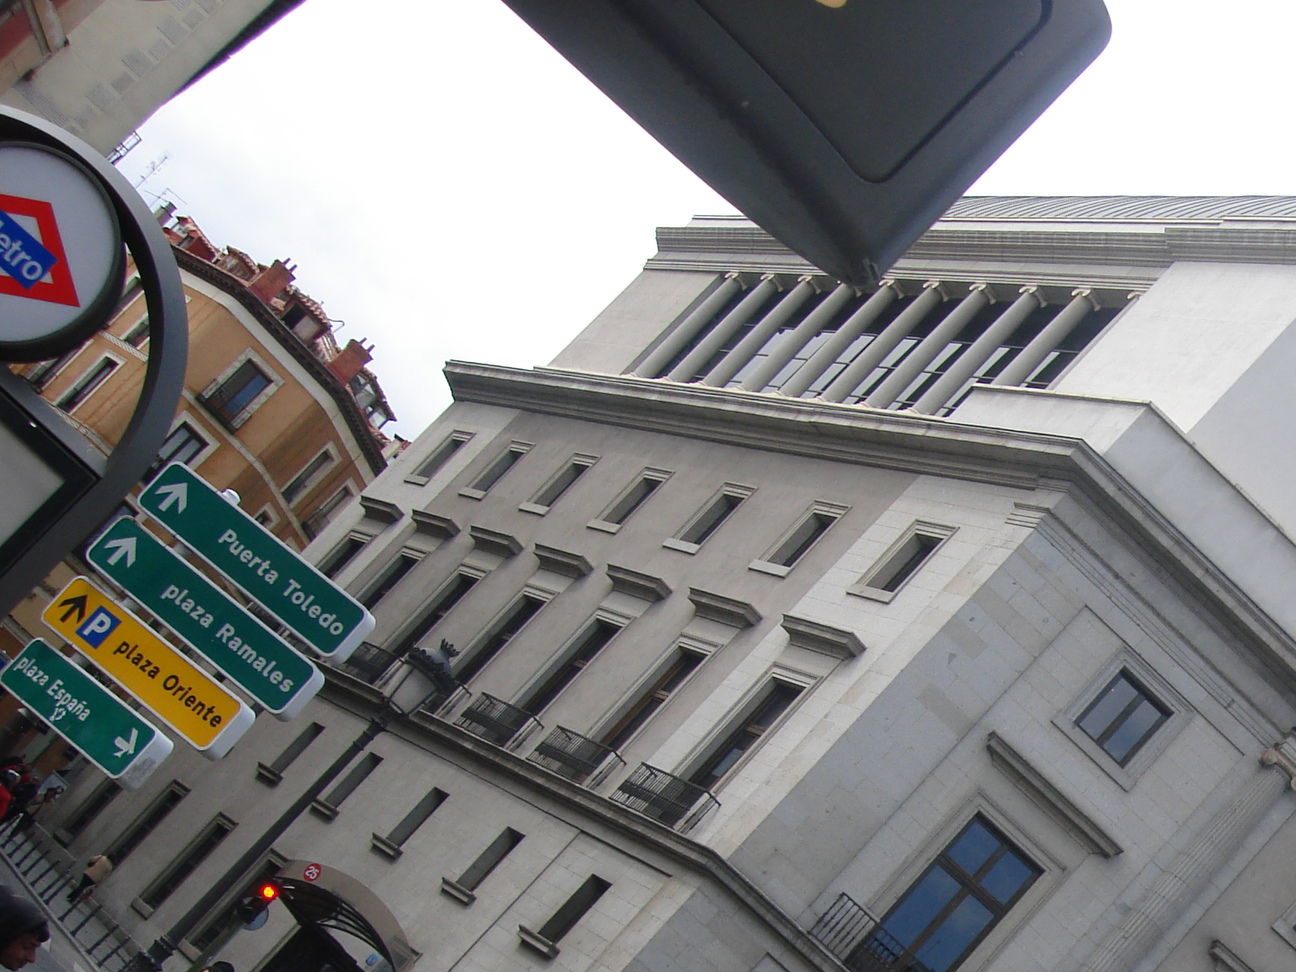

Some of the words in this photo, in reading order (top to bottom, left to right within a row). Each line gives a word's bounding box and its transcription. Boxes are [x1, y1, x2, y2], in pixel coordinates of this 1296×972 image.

[0, 221, 43, 280] etro
[218, 528, 279, 585] Puerta
[283, 578, 344, 635] Toledo
[83, 612, 112, 636] P
[112, 641, 161, 679] plaza
[162, 674, 222, 728] Oriente
[160, 584, 214, 628] plaza
[215, 623, 294, 693] Ramales
[13, 657, 50, 686] plaza
[47, 679, 91, 721] España
[304, 865, 320, 880] 25
